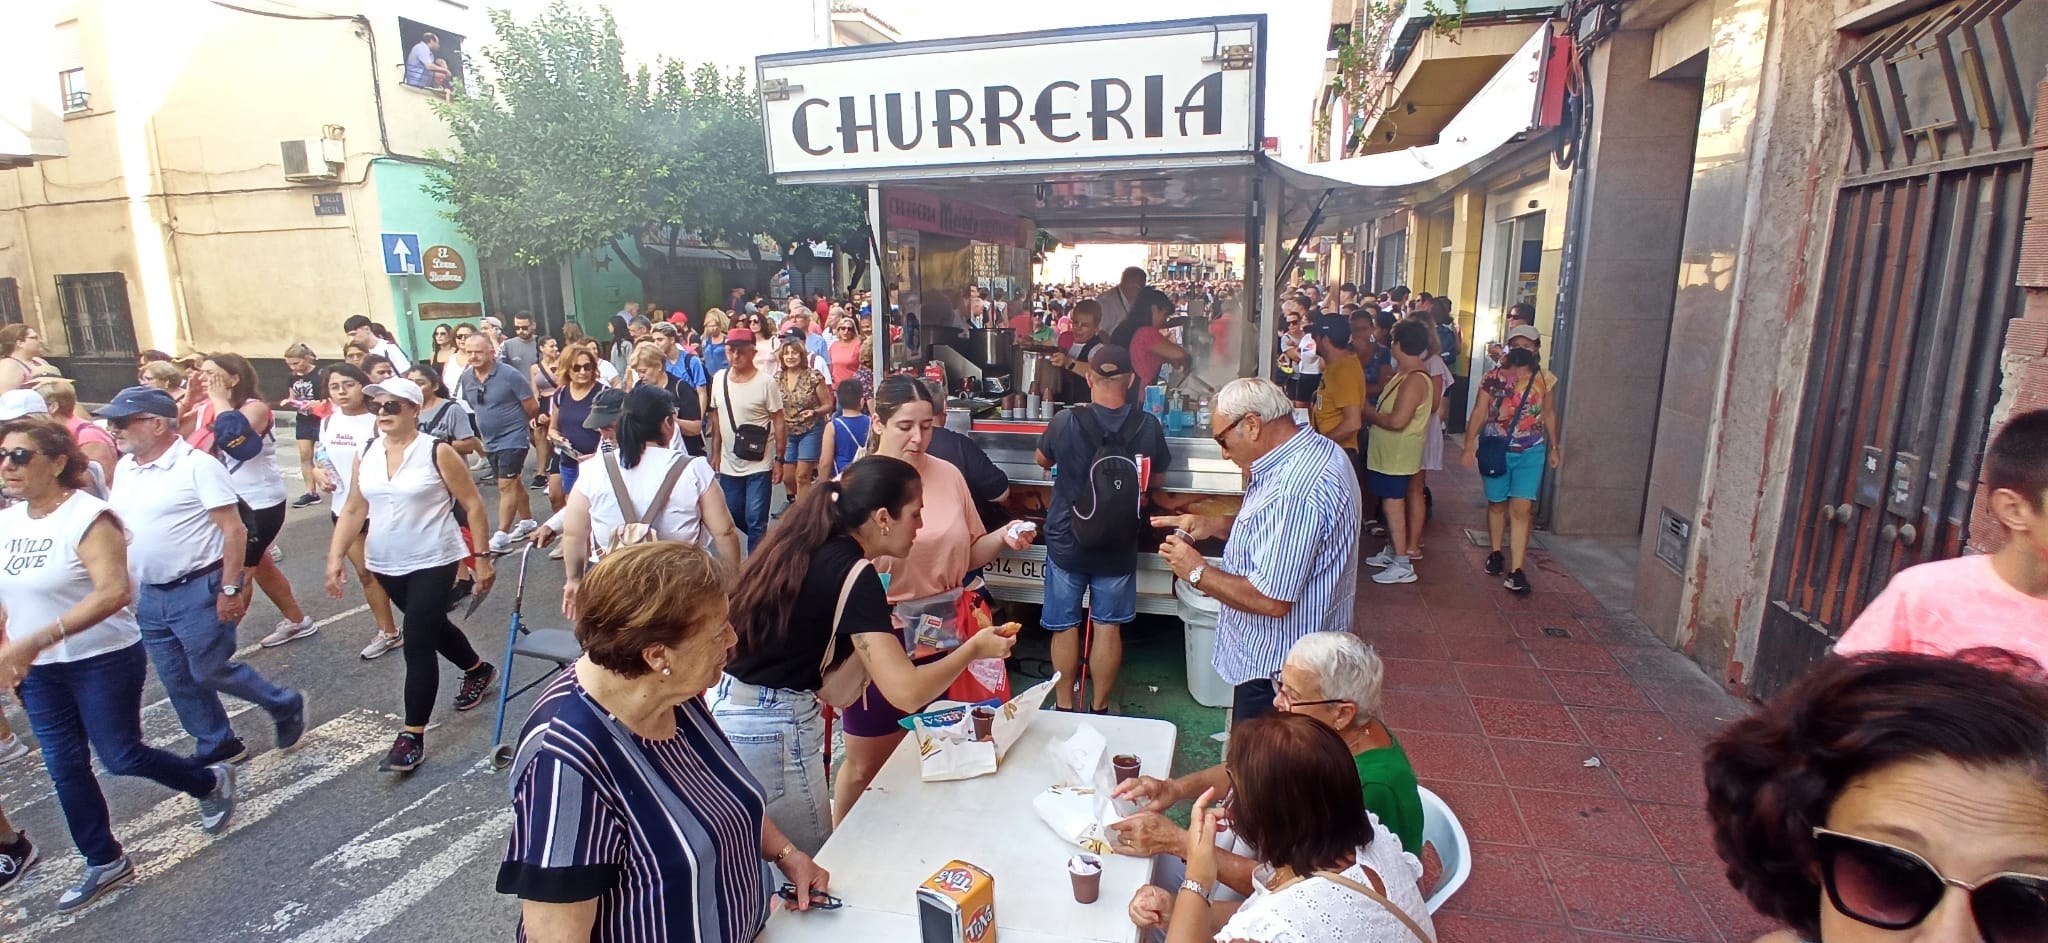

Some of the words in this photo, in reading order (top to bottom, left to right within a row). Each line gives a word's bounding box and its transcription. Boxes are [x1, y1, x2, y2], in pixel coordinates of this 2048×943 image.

[792, 71, 1223, 156] CHURRERIA
[5, 538, 53, 553] WILD
[4, 555, 48, 576] LOVE
